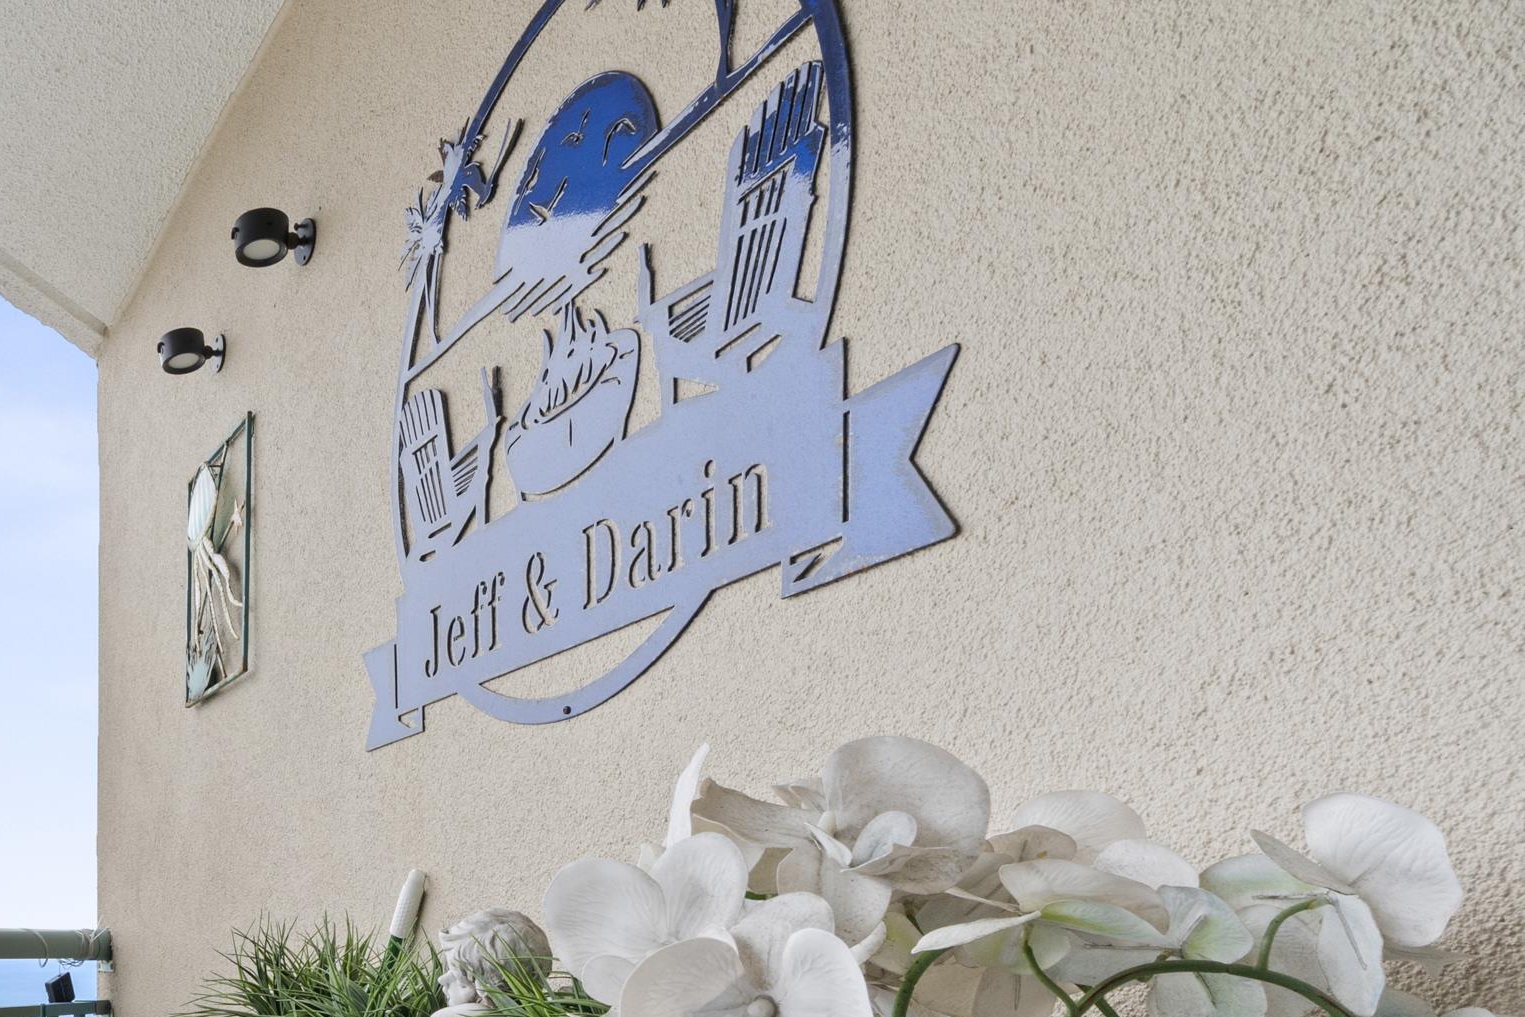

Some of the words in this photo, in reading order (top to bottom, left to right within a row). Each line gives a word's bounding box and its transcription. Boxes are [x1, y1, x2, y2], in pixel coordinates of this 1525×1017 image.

[423, 571, 507, 679] Jeff
[521, 551, 560, 635] &
[582, 459, 775, 611] Darin
